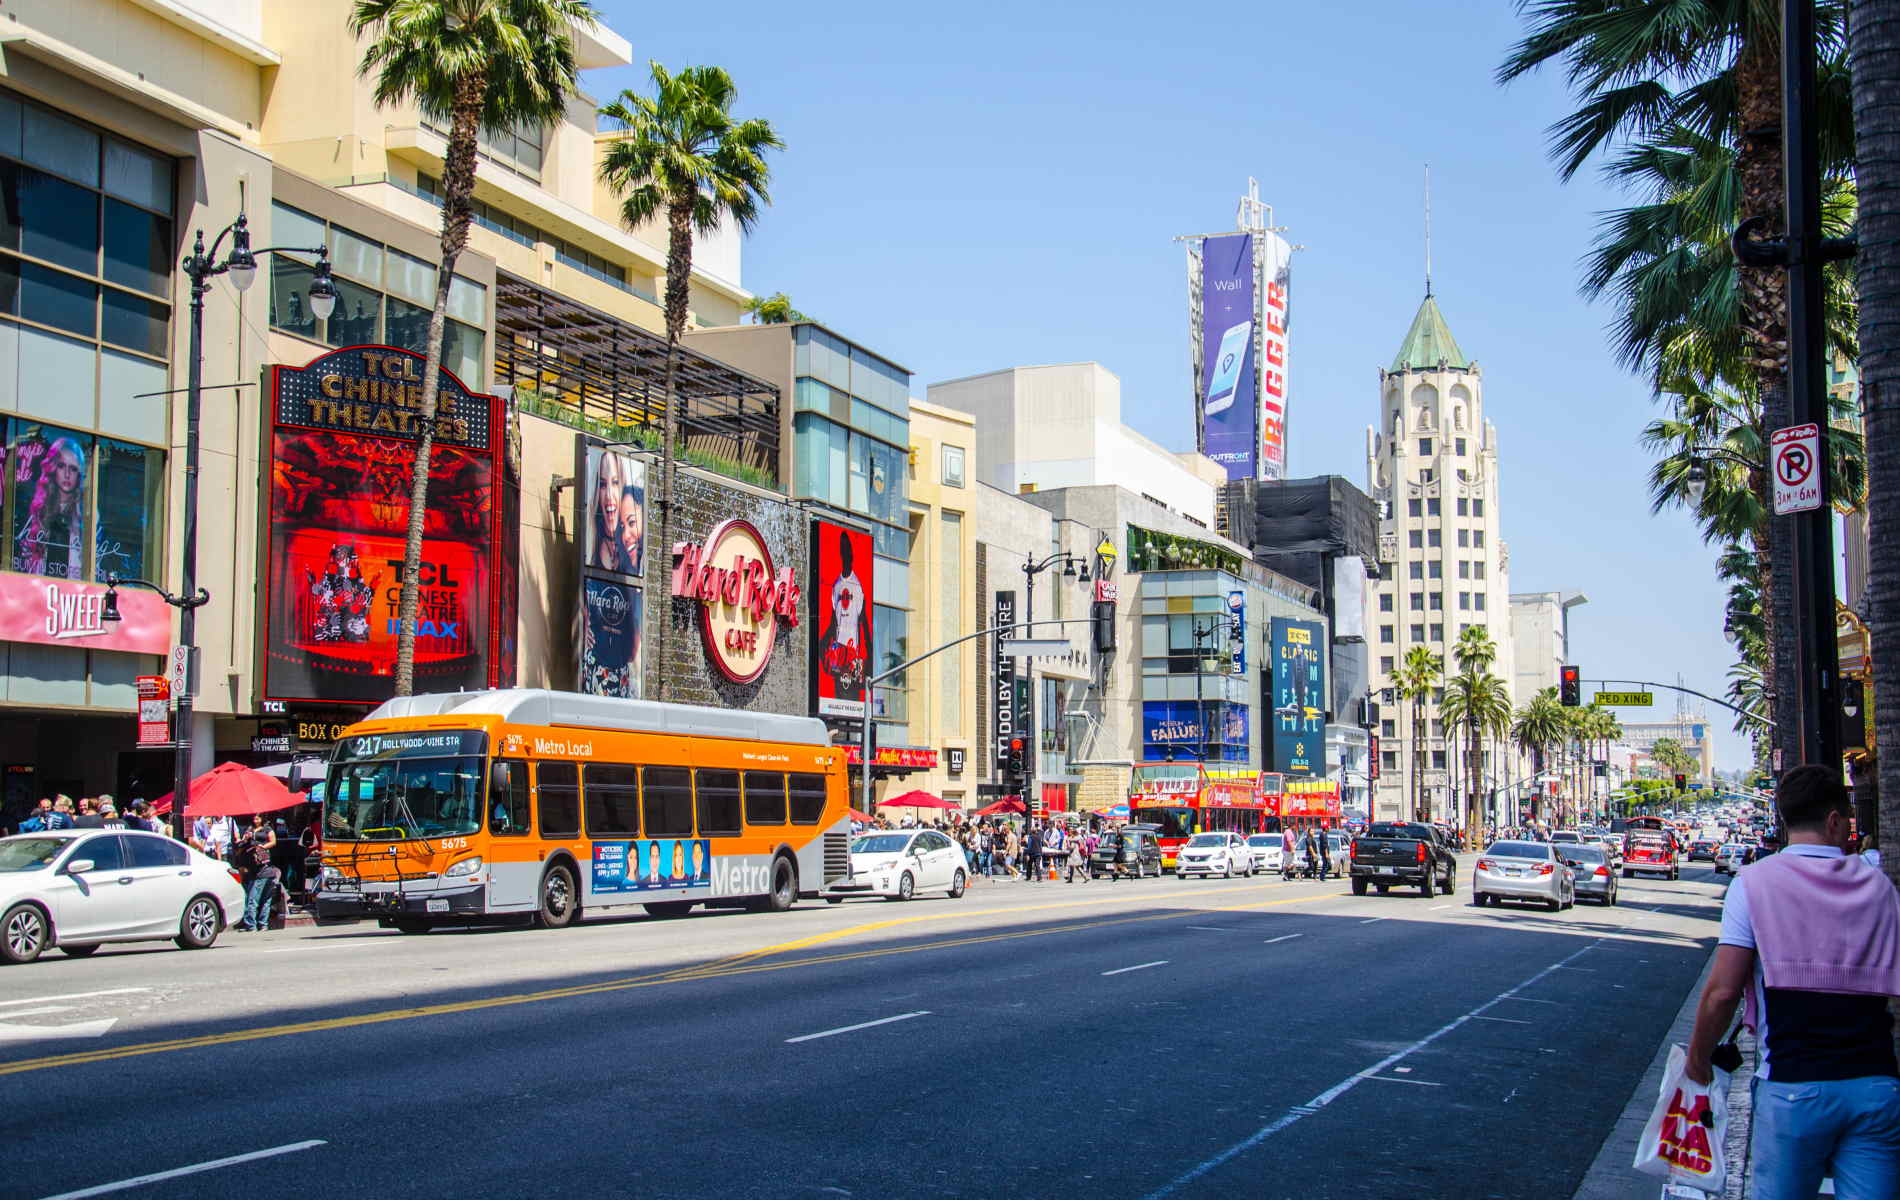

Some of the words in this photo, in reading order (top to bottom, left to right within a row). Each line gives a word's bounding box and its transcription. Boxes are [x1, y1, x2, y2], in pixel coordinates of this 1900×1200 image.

[1214, 279, 1242, 291] Wall
[361, 351, 420, 382] TCL
[1264, 280, 1284, 446] BIGGER
[320, 374, 457, 414] CHINEE
[306, 399, 469, 441] THEATES
[1776, 490, 1791, 505] 3AM
[1800, 487, 1817, 501] 6AM
[387, 560, 458, 587] TCL
[672, 541, 745, 606] Hard
[741, 558, 800, 628] Rock
[386, 587, 459, 608] CNESE
[386, 603, 459, 622] TATRE
[725, 628, 757, 653] CAFE
[1281, 645, 1318, 662] CLASIC
[1281, 662, 1318, 681] FM
[263, 701, 286, 712] TCL
[998, 680, 1012, 735] DOLBY
[1598, 694, 1620, 704] PED
[1623, 694, 1649, 704] XING
[260, 737, 289, 745] CHINESE
[299, 723, 327, 740] BOX
[356, 737, 381, 756] 217
[535, 738, 565, 754] Metro
[567, 740, 593, 756] Local
[441, 839, 467, 849] 5675
[710, 856, 770, 896] Metro
[1657, 1142, 1713, 1174] LAND
